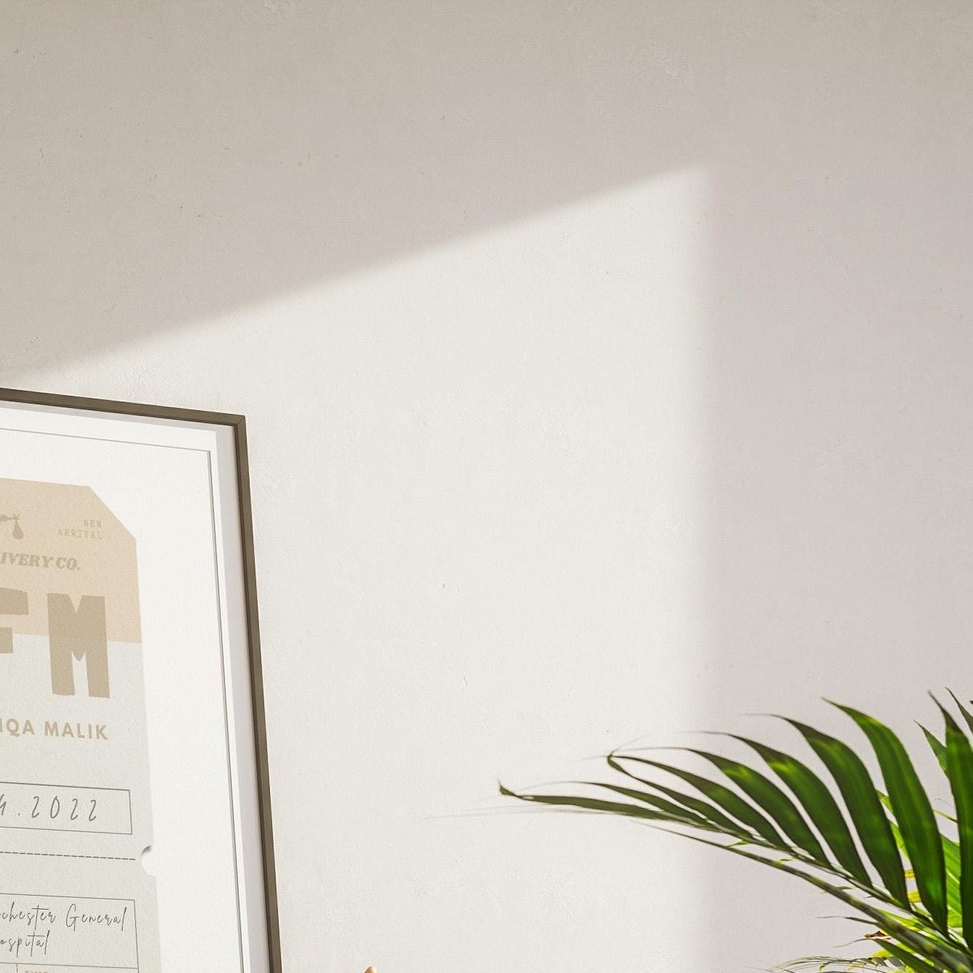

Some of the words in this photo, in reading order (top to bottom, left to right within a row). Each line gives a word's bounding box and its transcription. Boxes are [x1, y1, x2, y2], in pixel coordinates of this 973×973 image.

[83, 518, 102, 529] NEW
[57, 528, 103, 540] ARRIVAL
[55, 556, 80, 570] CO.
[43, 721, 108, 740] MALIK
[65, 903, 128, 932] General
